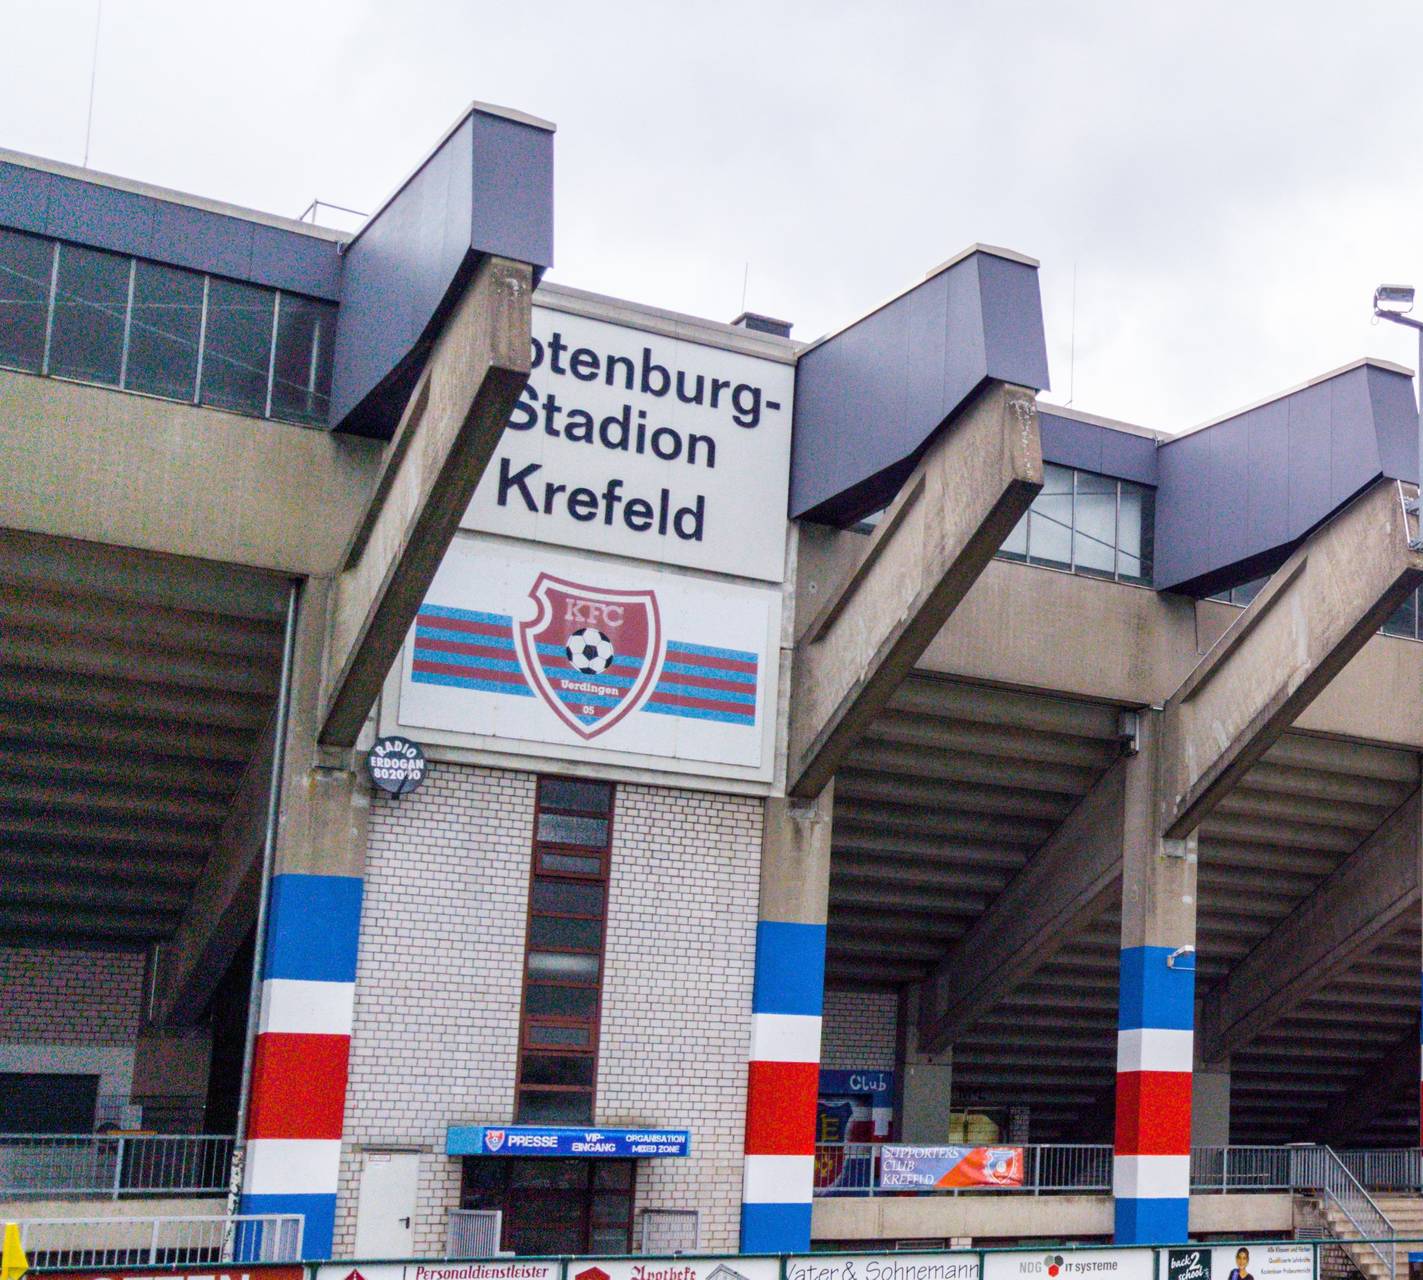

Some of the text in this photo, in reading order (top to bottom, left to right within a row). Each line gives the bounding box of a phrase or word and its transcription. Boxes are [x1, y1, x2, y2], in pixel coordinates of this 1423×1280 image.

[531, 331, 780, 429] tenburg-
[506, 383, 716, 468] Stadion
[497, 457, 706, 541] Krefeld
[564, 598, 624, 627] KFC
[561, 679, 619, 696] Uerdingen
[583, 705, 595, 715] 05
[374, 740, 417, 757] RADIO
[370, 756, 424, 769] ERDOGAN
[849, 1073, 887, 1092] Club
[508, 1135, 558, 1147] PRESSE
[585, 1132, 605, 1142] VIP-
[625, 1134, 686, 1143] ORGANISATION
[571, 1142, 616, 1152] EINGANG
[632, 1145, 681, 1154] MIXED ZONE
[884, 1146, 959, 1159] SUPPORTERS
[883, 1160, 915, 1172] CLUB
[1019, 1262, 1042, 1273] NDG
[1065, 1263, 1073, 1272] IT
[1170, 1254, 1191, 1269] back
[416, 1264, 549, 1280] Personaldienstleister
[630, 1265, 696, 1280] Apotheke
[842, 1261, 857, 1280] &
[866, 1261, 980, 1280] Sohnemann
[1178, 1265, 1203, 1280] school
